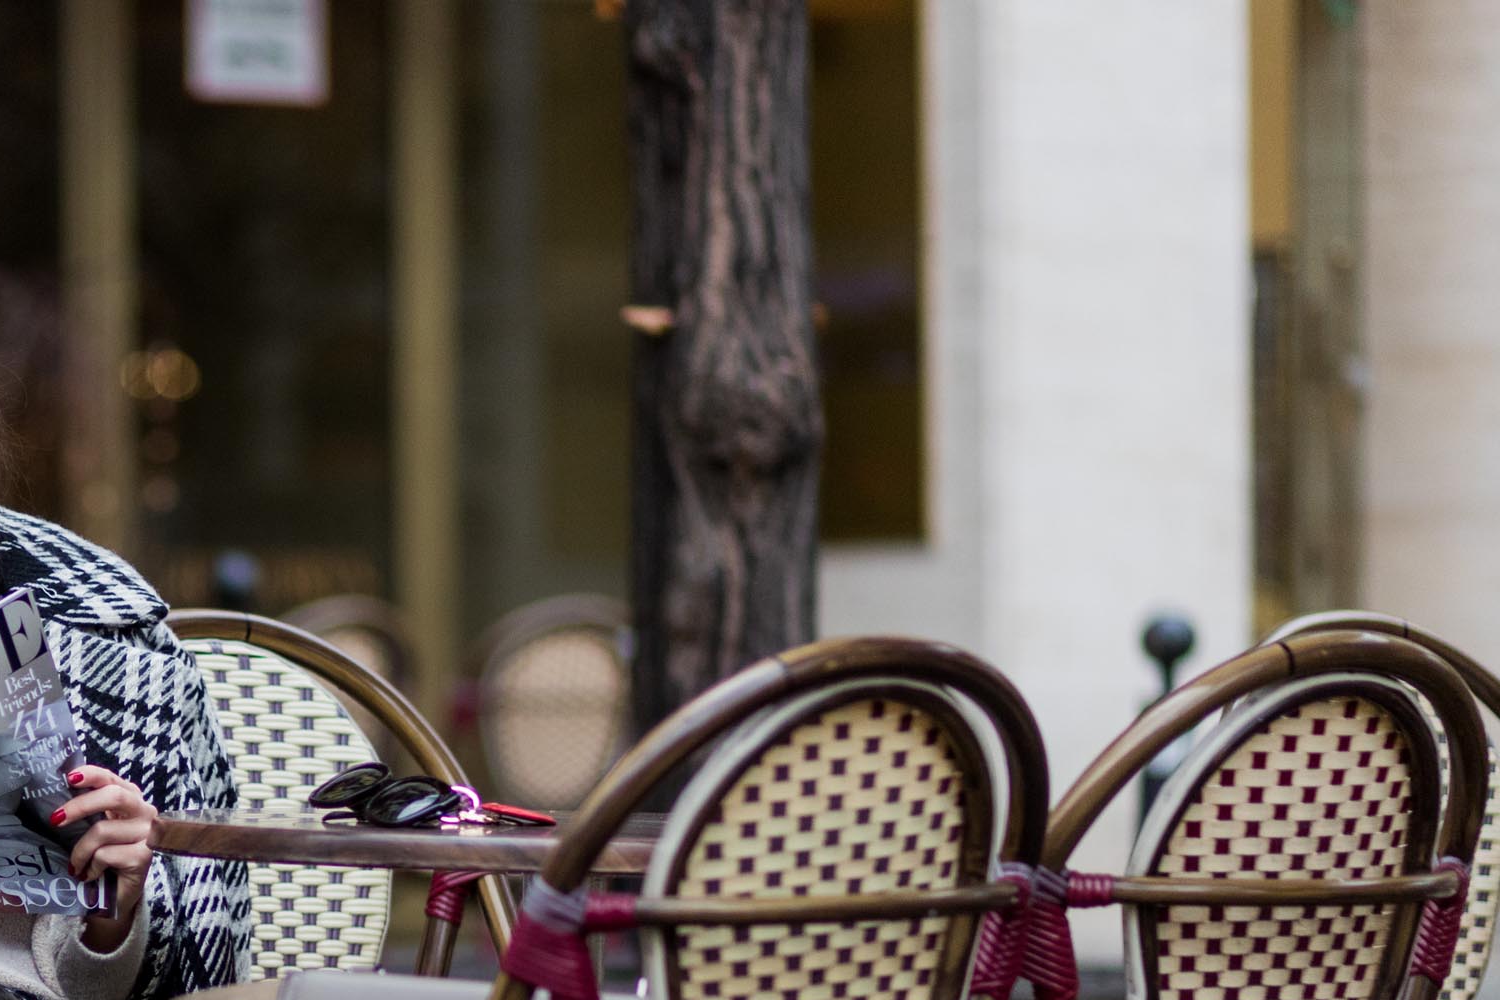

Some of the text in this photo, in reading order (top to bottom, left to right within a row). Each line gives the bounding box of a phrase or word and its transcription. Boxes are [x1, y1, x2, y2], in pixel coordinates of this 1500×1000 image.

[5, 668, 35, 695] Best
[10, 697, 57, 743] 44
[8, 737, 79, 777] Schmuck
[45, 770, 62, 784] &
